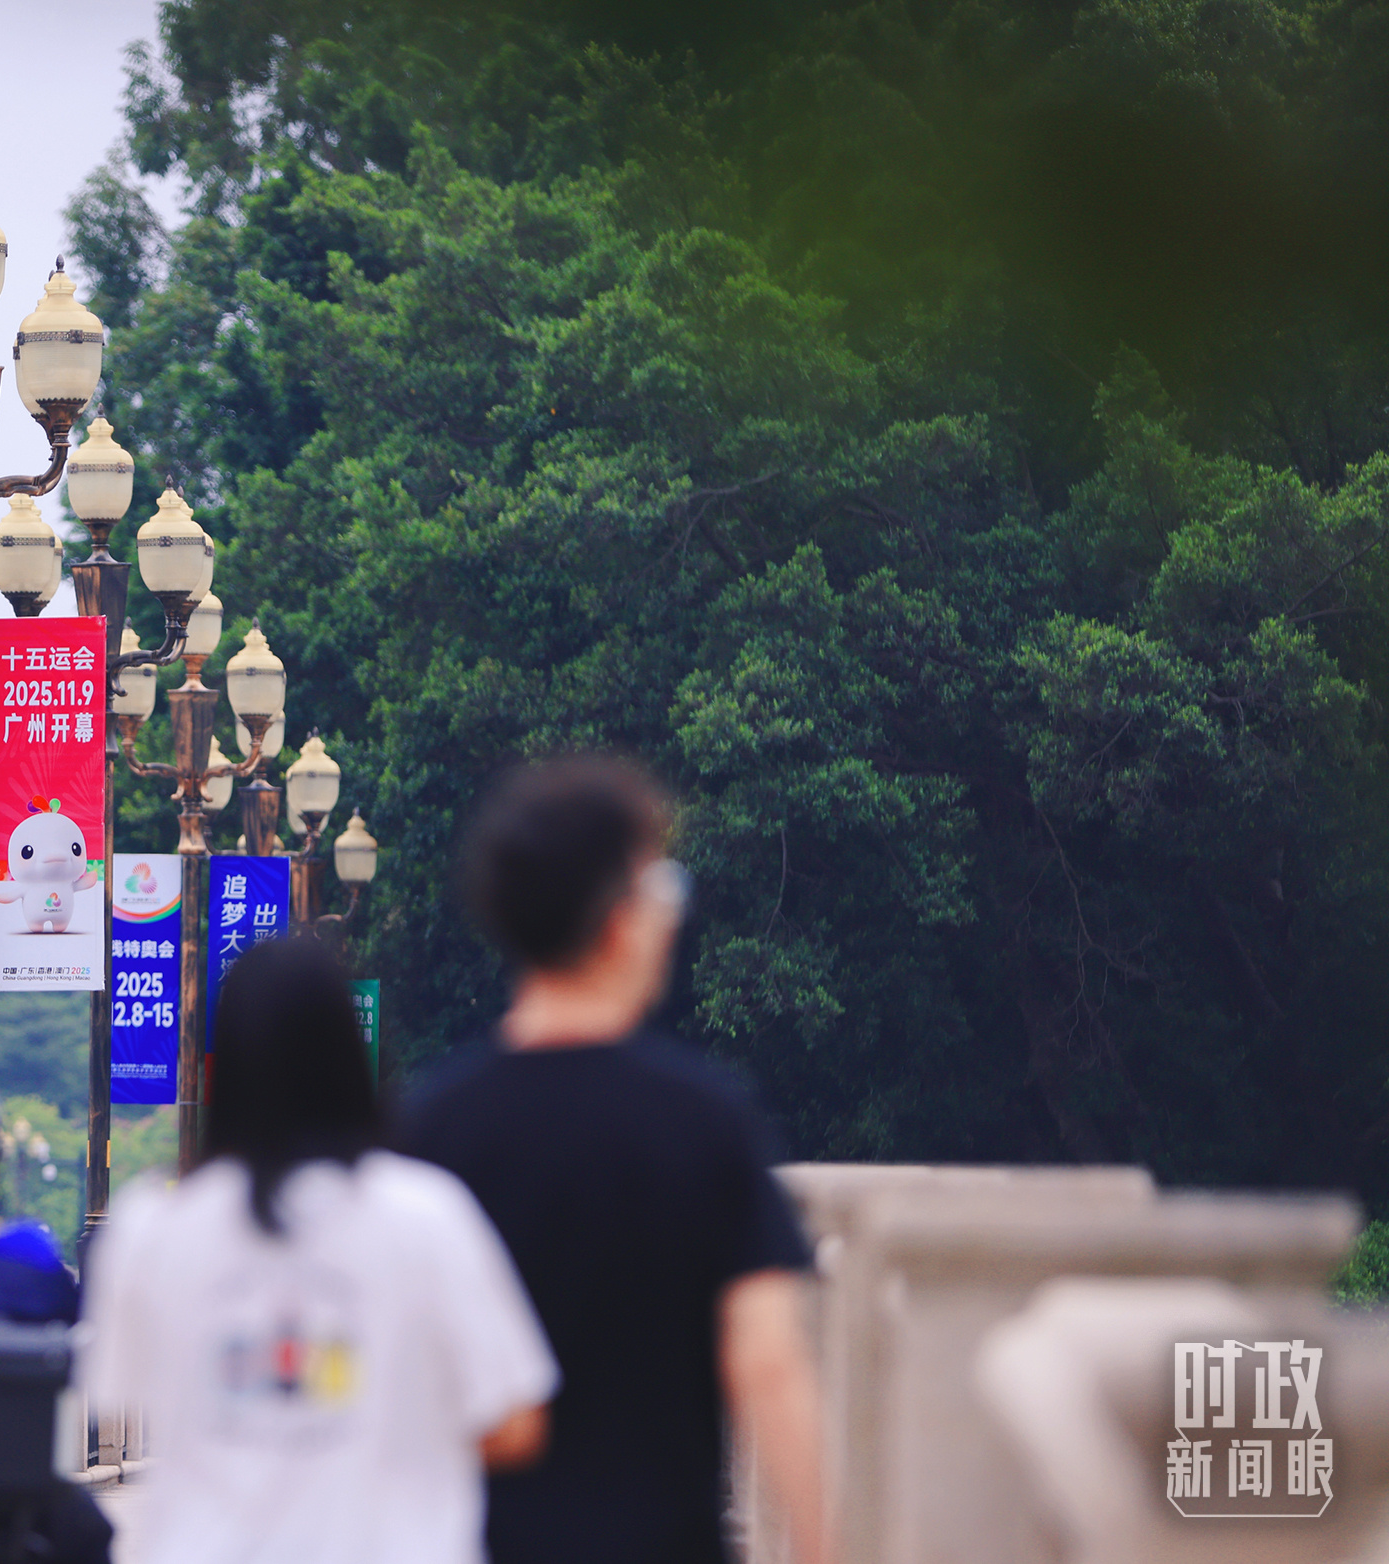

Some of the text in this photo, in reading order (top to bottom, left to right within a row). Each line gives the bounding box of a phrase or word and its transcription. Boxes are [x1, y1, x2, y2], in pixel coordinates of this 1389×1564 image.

[2, 646, 95, 671] 十五运会
[3, 680, 94, 706] 2025.11.9
[3, 712, 94, 744] 广州开幕
[116, 971, 164, 998] 2025
[112, 1001, 174, 1028] 2.8-15
